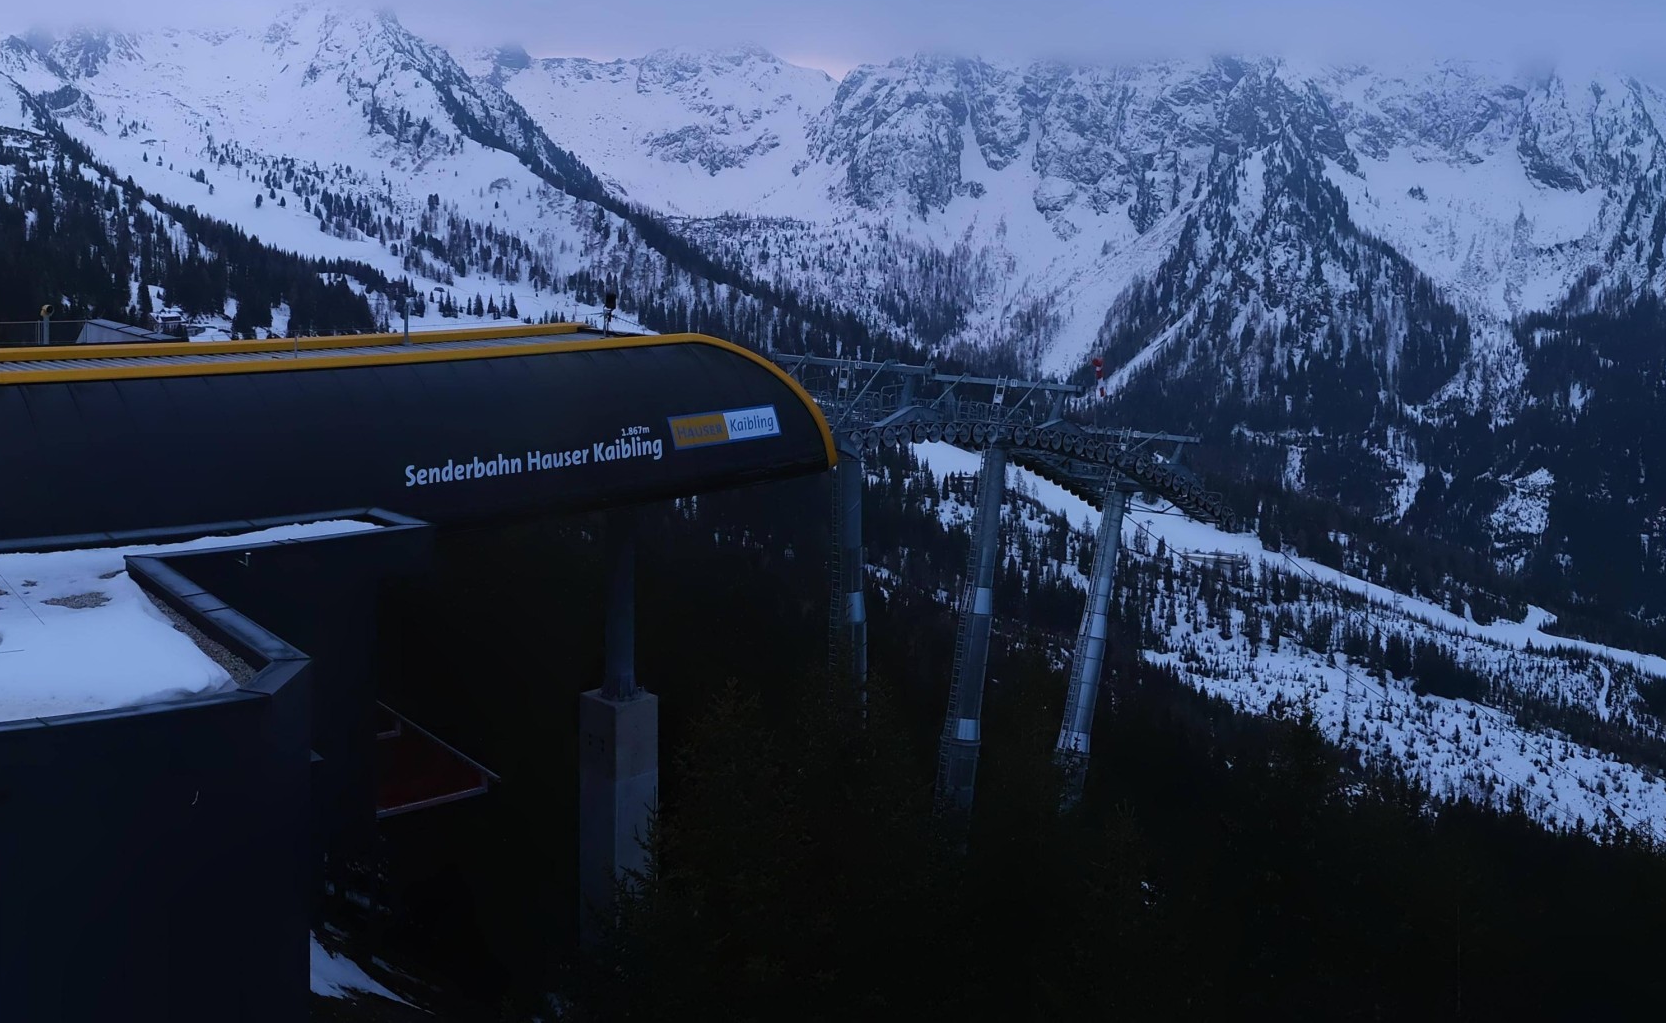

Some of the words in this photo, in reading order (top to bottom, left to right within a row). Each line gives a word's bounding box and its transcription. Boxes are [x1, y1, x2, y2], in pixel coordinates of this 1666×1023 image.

[621, 425, 650, 436] 1.867m
[676, 423, 723, 439] HAUSER
[730, 414, 775, 434] Kaibling
[405, 456, 522, 487] Senderbahn
[527, 446, 589, 471] Hauser
[593, 435, 663, 461] Kaibling
